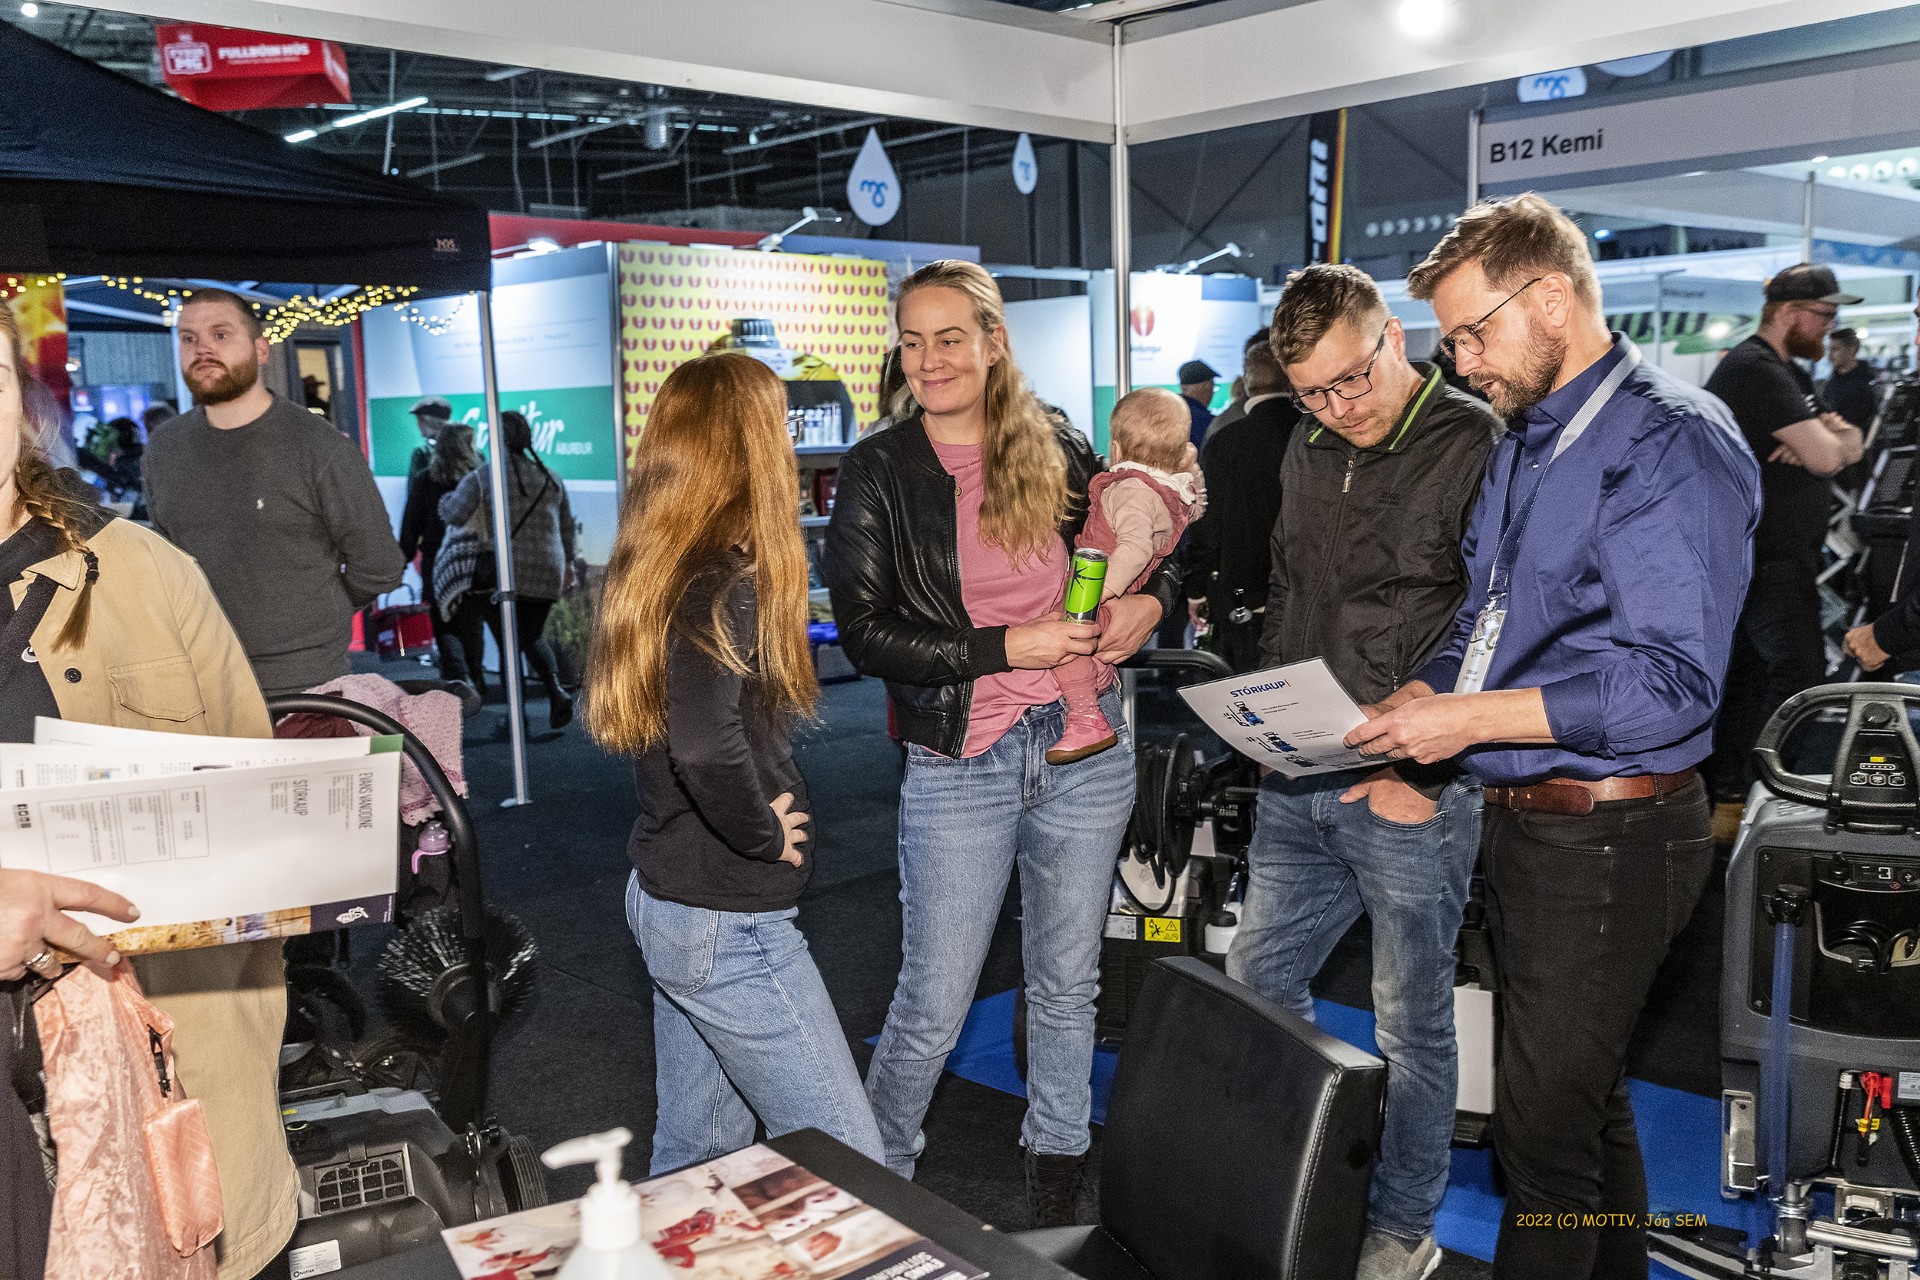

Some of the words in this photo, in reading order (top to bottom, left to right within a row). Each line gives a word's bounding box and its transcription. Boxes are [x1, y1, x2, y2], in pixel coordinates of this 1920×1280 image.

[1489, 138, 1534, 164] B12
[1541, 127, 1604, 157] Kemi
[1229, 680, 1286, 698] STÓRKAUP
[293, 779, 311, 816] STÓRKAUP
[359, 772, 373, 794] EVANS
